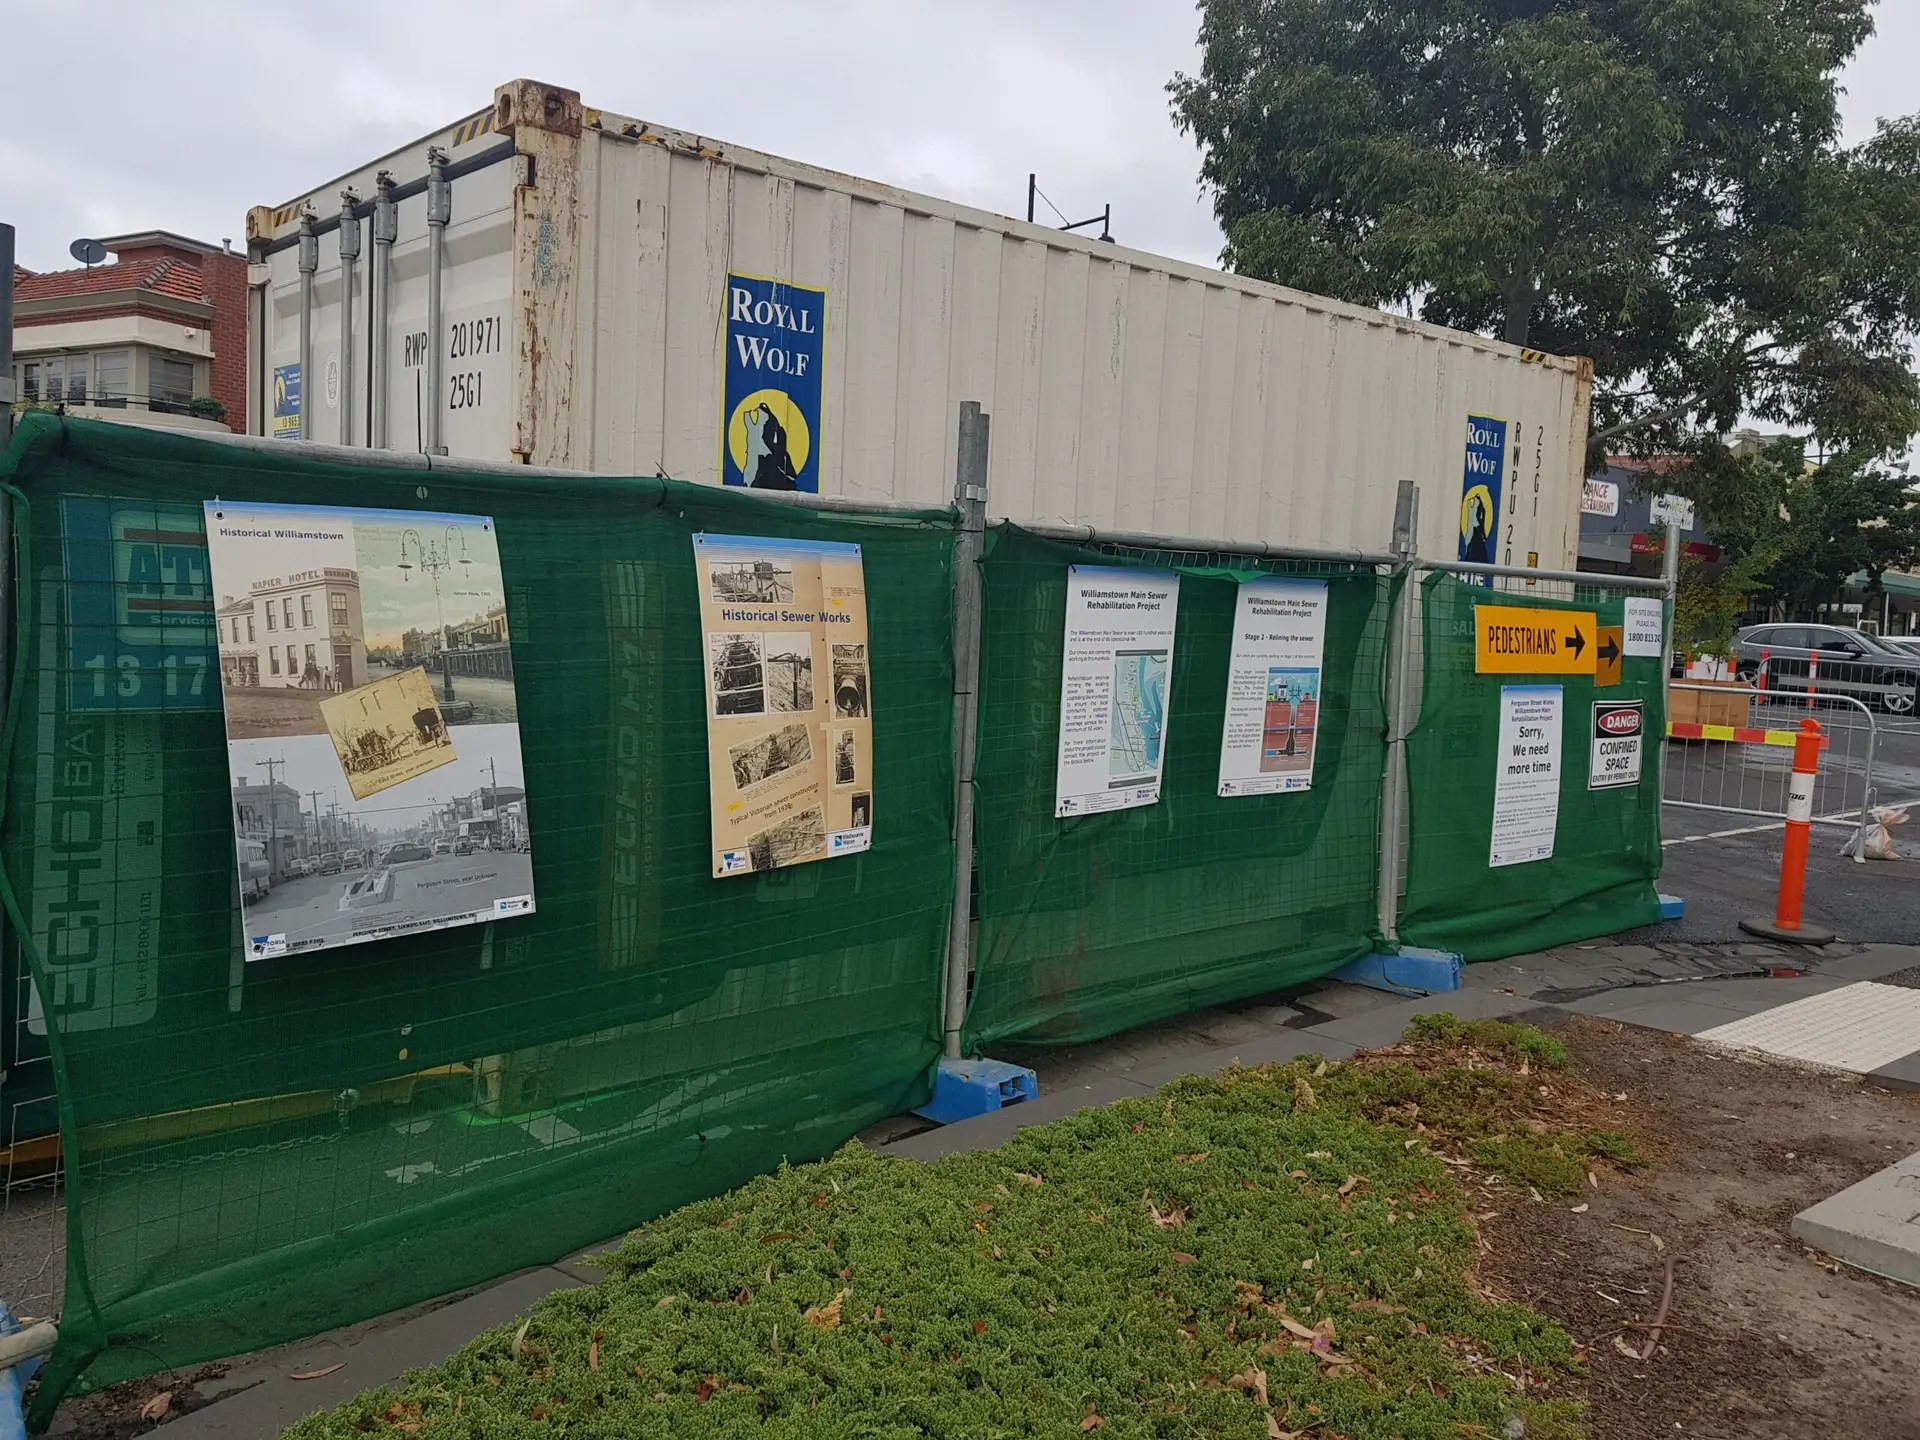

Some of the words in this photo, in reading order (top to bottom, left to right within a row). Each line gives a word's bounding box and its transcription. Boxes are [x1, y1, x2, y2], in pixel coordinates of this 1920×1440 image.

[730, 287, 814, 334] ROYAL
[405, 332, 428, 368] RWP
[451, 316, 500, 358] 201971
[734, 334, 809, 376] WOLF
[450, 371, 481, 409] 25G1
[1585, 482, 1609, 499] ANCE
[1582, 498, 1614, 514] ESTAURANT
[220, 528, 271, 538] Historical
[274, 530, 344, 540] Williamstown
[252, 578, 282, 590] NAPIER
[1081, 590, 1128, 599] Williamstown
[1130, 590, 1146, 600] Main
[1148, 592, 1168, 600] Sewer
[1087, 601, 1136, 610] Rehabilitation
[1137, 602, 1160, 612] Project
[1248, 597, 1286, 606] Williamstown
[1301, 600, 1318, 608] Sewer
[722, 609, 778, 622] Historical
[781, 610, 815, 622] Sewer
[818, 612, 851, 624] Works
[1252, 608, 1292, 616] Rehabilitation
[1292, 610, 1312, 618] Project
[1452, 620, 1476, 637] SAL
[1244, 633, 1260, 641] Stage
[1269, 634, 1290, 642] Relining
[1488, 625, 1556, 655] PEDESTRIANS
[1629, 633, 1643, 641] 1800
[84, 654, 142, 697] 13
[158, 654, 208, 696] 17
[1606, 715, 1639, 728] DANGER
[1519, 726, 1544, 740] Sorry,
[1513, 744, 1526, 756] We
[1529, 742, 1549, 755] need
[1600, 740, 1638, 755] CONFINED
[1508, 764, 1530, 775] more
[1532, 760, 1551, 773] time
[1605, 757, 1630, 771] SPACE
[1593, 774, 1607, 782] ENTRY
[1614, 772, 1628, 780] PERMIT
[730, 815, 748, 825] Typical
[749, 804, 772, 817] Victorian
[790, 782, 820, 800] construction
[416, 880, 441, 889] Ferguson
[48, 801, 101, 1015] ECHO
